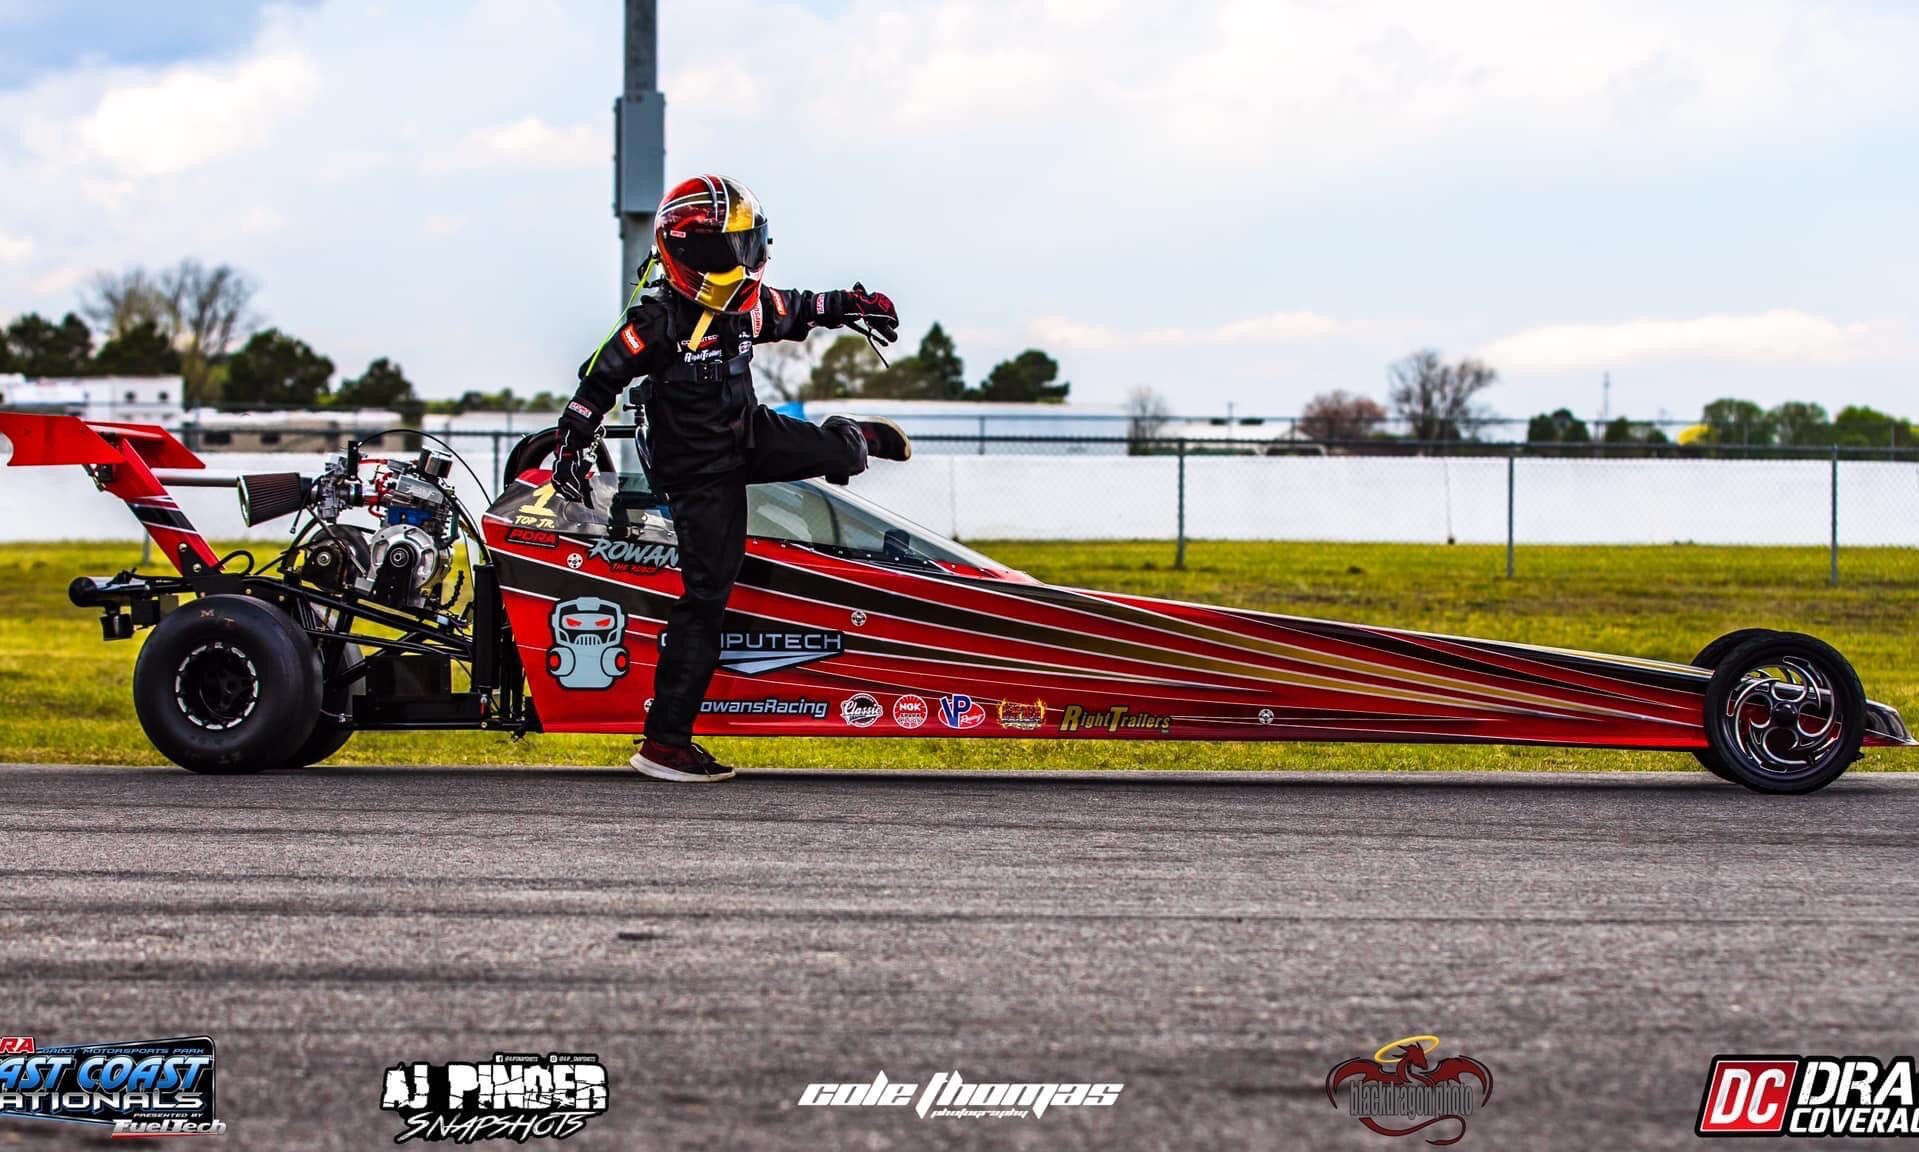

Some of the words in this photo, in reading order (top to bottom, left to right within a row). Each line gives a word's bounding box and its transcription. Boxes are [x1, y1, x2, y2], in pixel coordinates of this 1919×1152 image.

[519, 483, 557, 516] 1
[515, 515, 537, 527] TOP
[510, 530, 557, 544] PDRA
[589, 539, 679, 567] ROWAN
[700, 699, 828, 717] owansRacing
[844, 700, 882, 715] Classic
[899, 703, 921, 711] NGK
[940, 694, 971, 728] VP
[1060, 705, 1170, 732] RightTrailers
